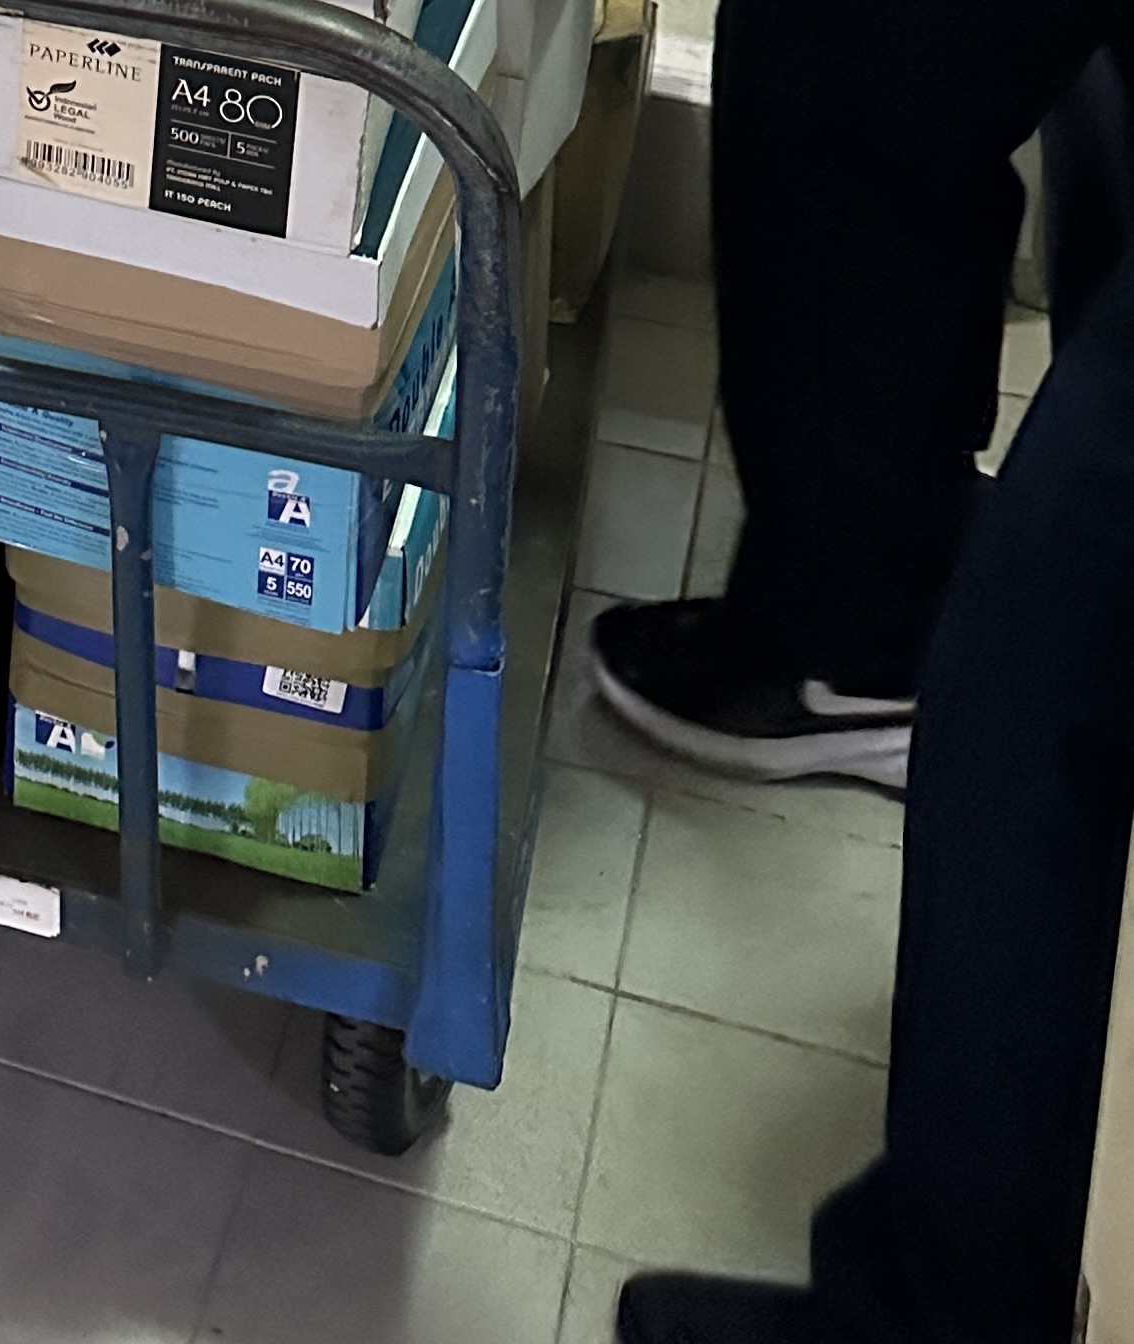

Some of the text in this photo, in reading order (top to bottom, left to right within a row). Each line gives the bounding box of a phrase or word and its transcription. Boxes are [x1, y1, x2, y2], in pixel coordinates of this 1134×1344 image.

[29, 43, 142, 82] PAPERLINE
[172, 56, 248, 79] TRANSPARENT
[53, 104, 90, 120] LEGAL
[171, 78, 283, 129] A4 80
[170, 127, 199, 144] 500
[235, 141, 246, 155] 5
[176, 191, 195, 204] 150
[197, 197, 232, 213] PEACH
[260, 551, 312, 574] A4 70
[266, 576, 312, 600] 5 550
